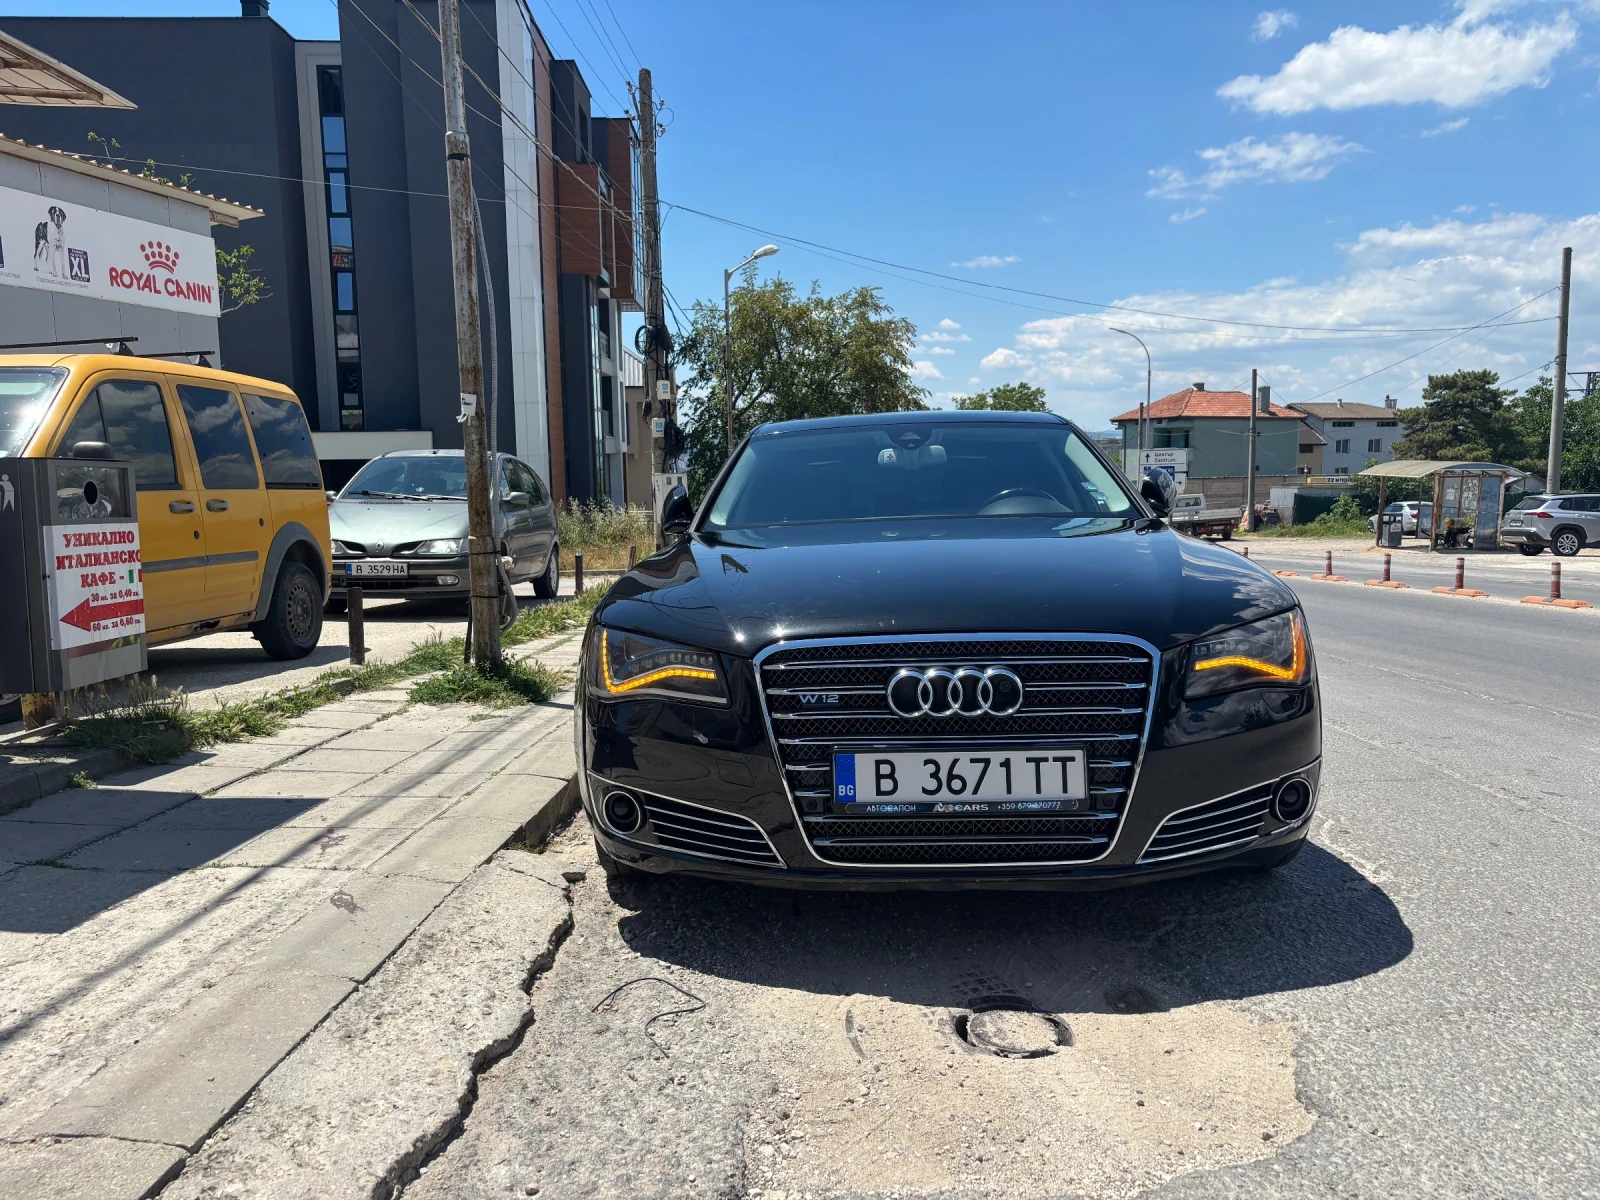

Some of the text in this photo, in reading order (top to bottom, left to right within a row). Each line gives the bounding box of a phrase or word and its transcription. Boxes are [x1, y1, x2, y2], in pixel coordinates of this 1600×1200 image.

[71, 256, 89, 278] XL
[109, 267, 161, 295] ROYAL
[164, 278, 212, 303] CANIN
[63, 530, 135, 548] УНИКАЛНО
[367, 565, 391, 574] 3529
[80, 571, 116, 588] КАФЕ
[91, 593, 99, 602] 30
[119, 589, 132, 600] 0,40
[92, 622, 101, 632] 60
[120, 617, 134, 628] 0,60
[800, 694, 839, 704] W12
[921, 757, 1012, 796] 3671
[838, 785, 854, 796] BG
